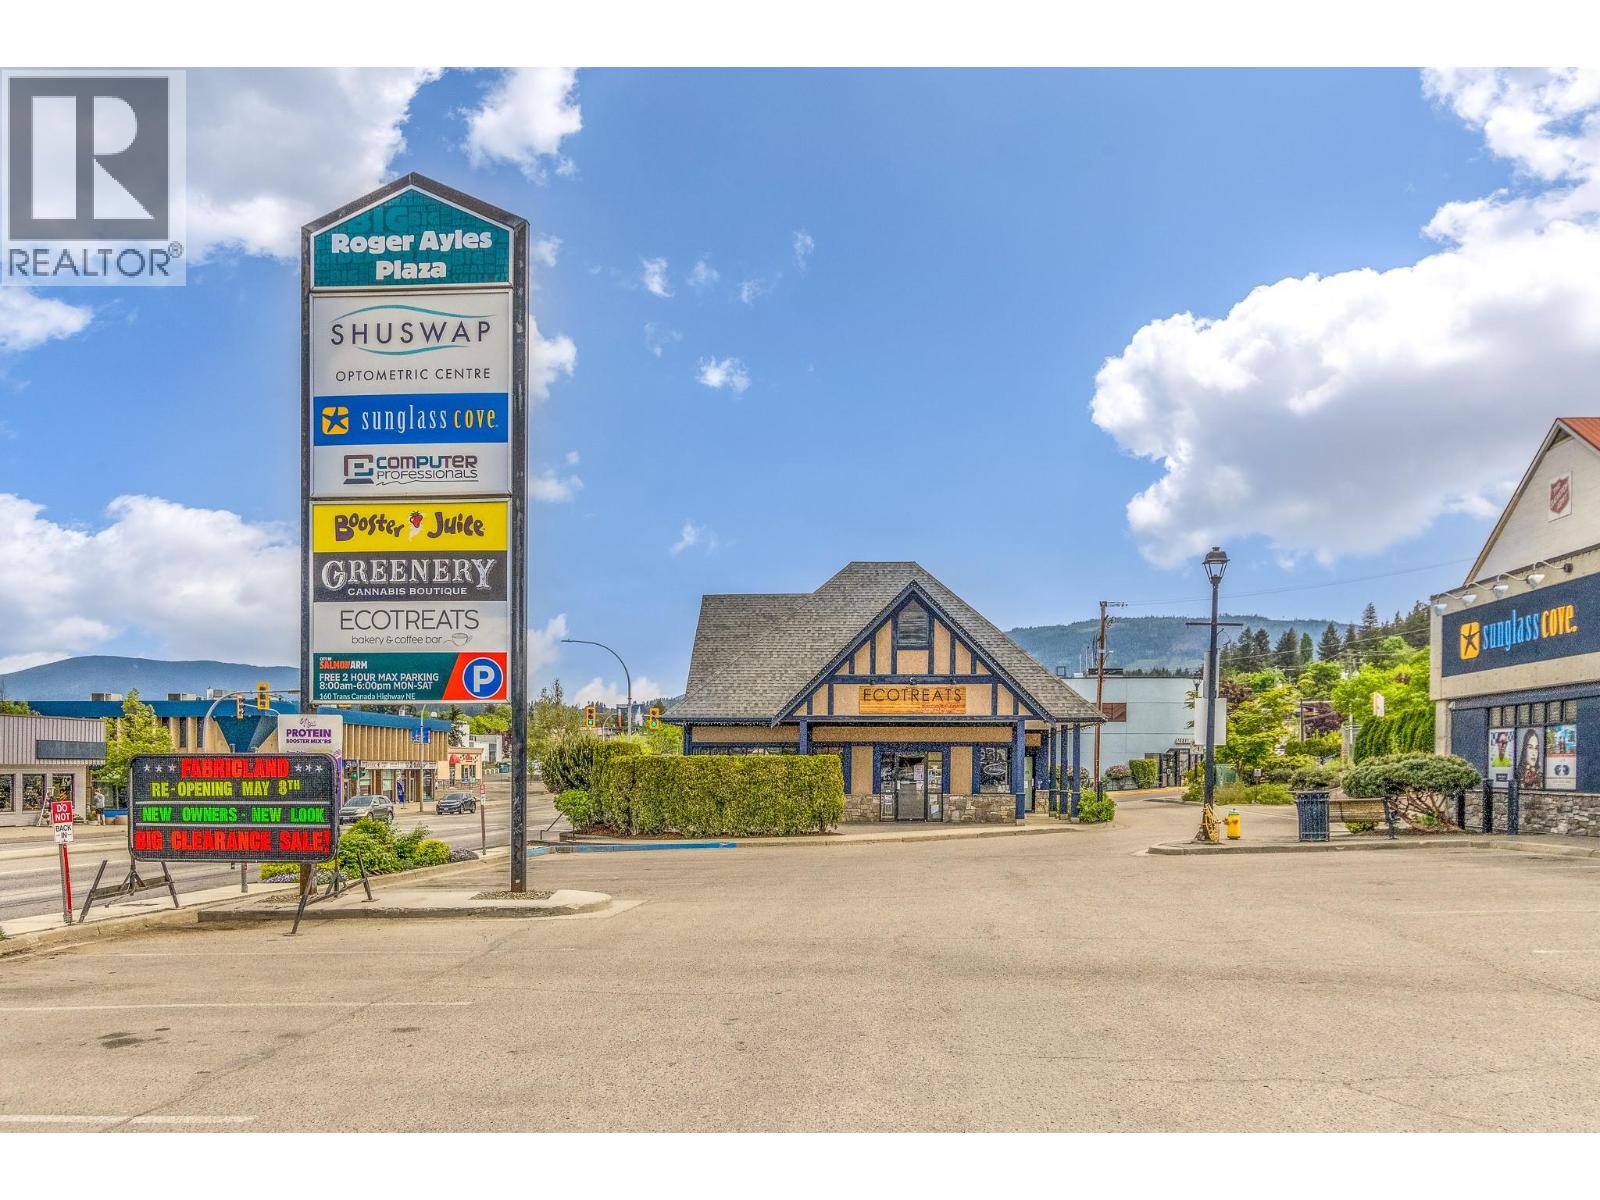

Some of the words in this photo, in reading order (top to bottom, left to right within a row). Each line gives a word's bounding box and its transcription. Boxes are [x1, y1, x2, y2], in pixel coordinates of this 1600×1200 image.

[331, 233, 415, 254] Roger
[419, 230, 493, 252] Ayles
[375, 260, 447, 280] Plaza
[330, 321, 492, 346] SHUSWAP
[335, 368, 429, 382] OPTOMETRIC
[435, 367, 491, 380] CENTRE
[361, 404, 447, 434] sunglass
[334, 512, 405, 542] Booster
[426, 511, 485, 538] Juice
[321, 558, 497, 591] GREENERY
[347, 587, 407, 596] CANNABIS
[409, 587, 468, 596] BOUTIQUE
[340, 609, 480, 631] ECOTREATS
[1482, 608, 1539, 652] sunglass
[351, 634, 384, 645] bakery
[386, 635, 394, 644] &
[394, 634, 424, 644] coffee
[425, 634, 443, 644] bar
[319, 673, 341, 682] FREE
[342, 673, 349, 682] 2
[350, 673, 376, 682] HOUR
[378, 673, 398, 682] MAX
[400, 672, 439, 682] PARKING
[319, 681, 392, 691] 8:00am-6:00pm
[393, 681, 433, 690] MON-SAT
[319, 692, 331, 700] 160
[332, 692, 351, 700] Trans
[351, 692, 376, 700] Canada
[376, 692, 405, 701] Highway
[405, 692, 416, 700] NE
[863, 688, 962, 702] ECOTREATS
[286, 728, 332, 738] PROTEIN
[181, 758, 290, 778] FABRICLAND
[242, 780, 270, 797] MAY
[278, 779, 301, 797] 8TH
[55, 812, 71, 822] NOT
[56, 804, 68, 813] DO
[142, 806, 172, 823] NEW
[251, 806, 282, 823] NEW
[289, 806, 325, 823] LOOK
[135, 830, 163, 850] BIG
[171, 830, 272, 851] CLEARANCE
[279, 830, 331, 855] SALE!
